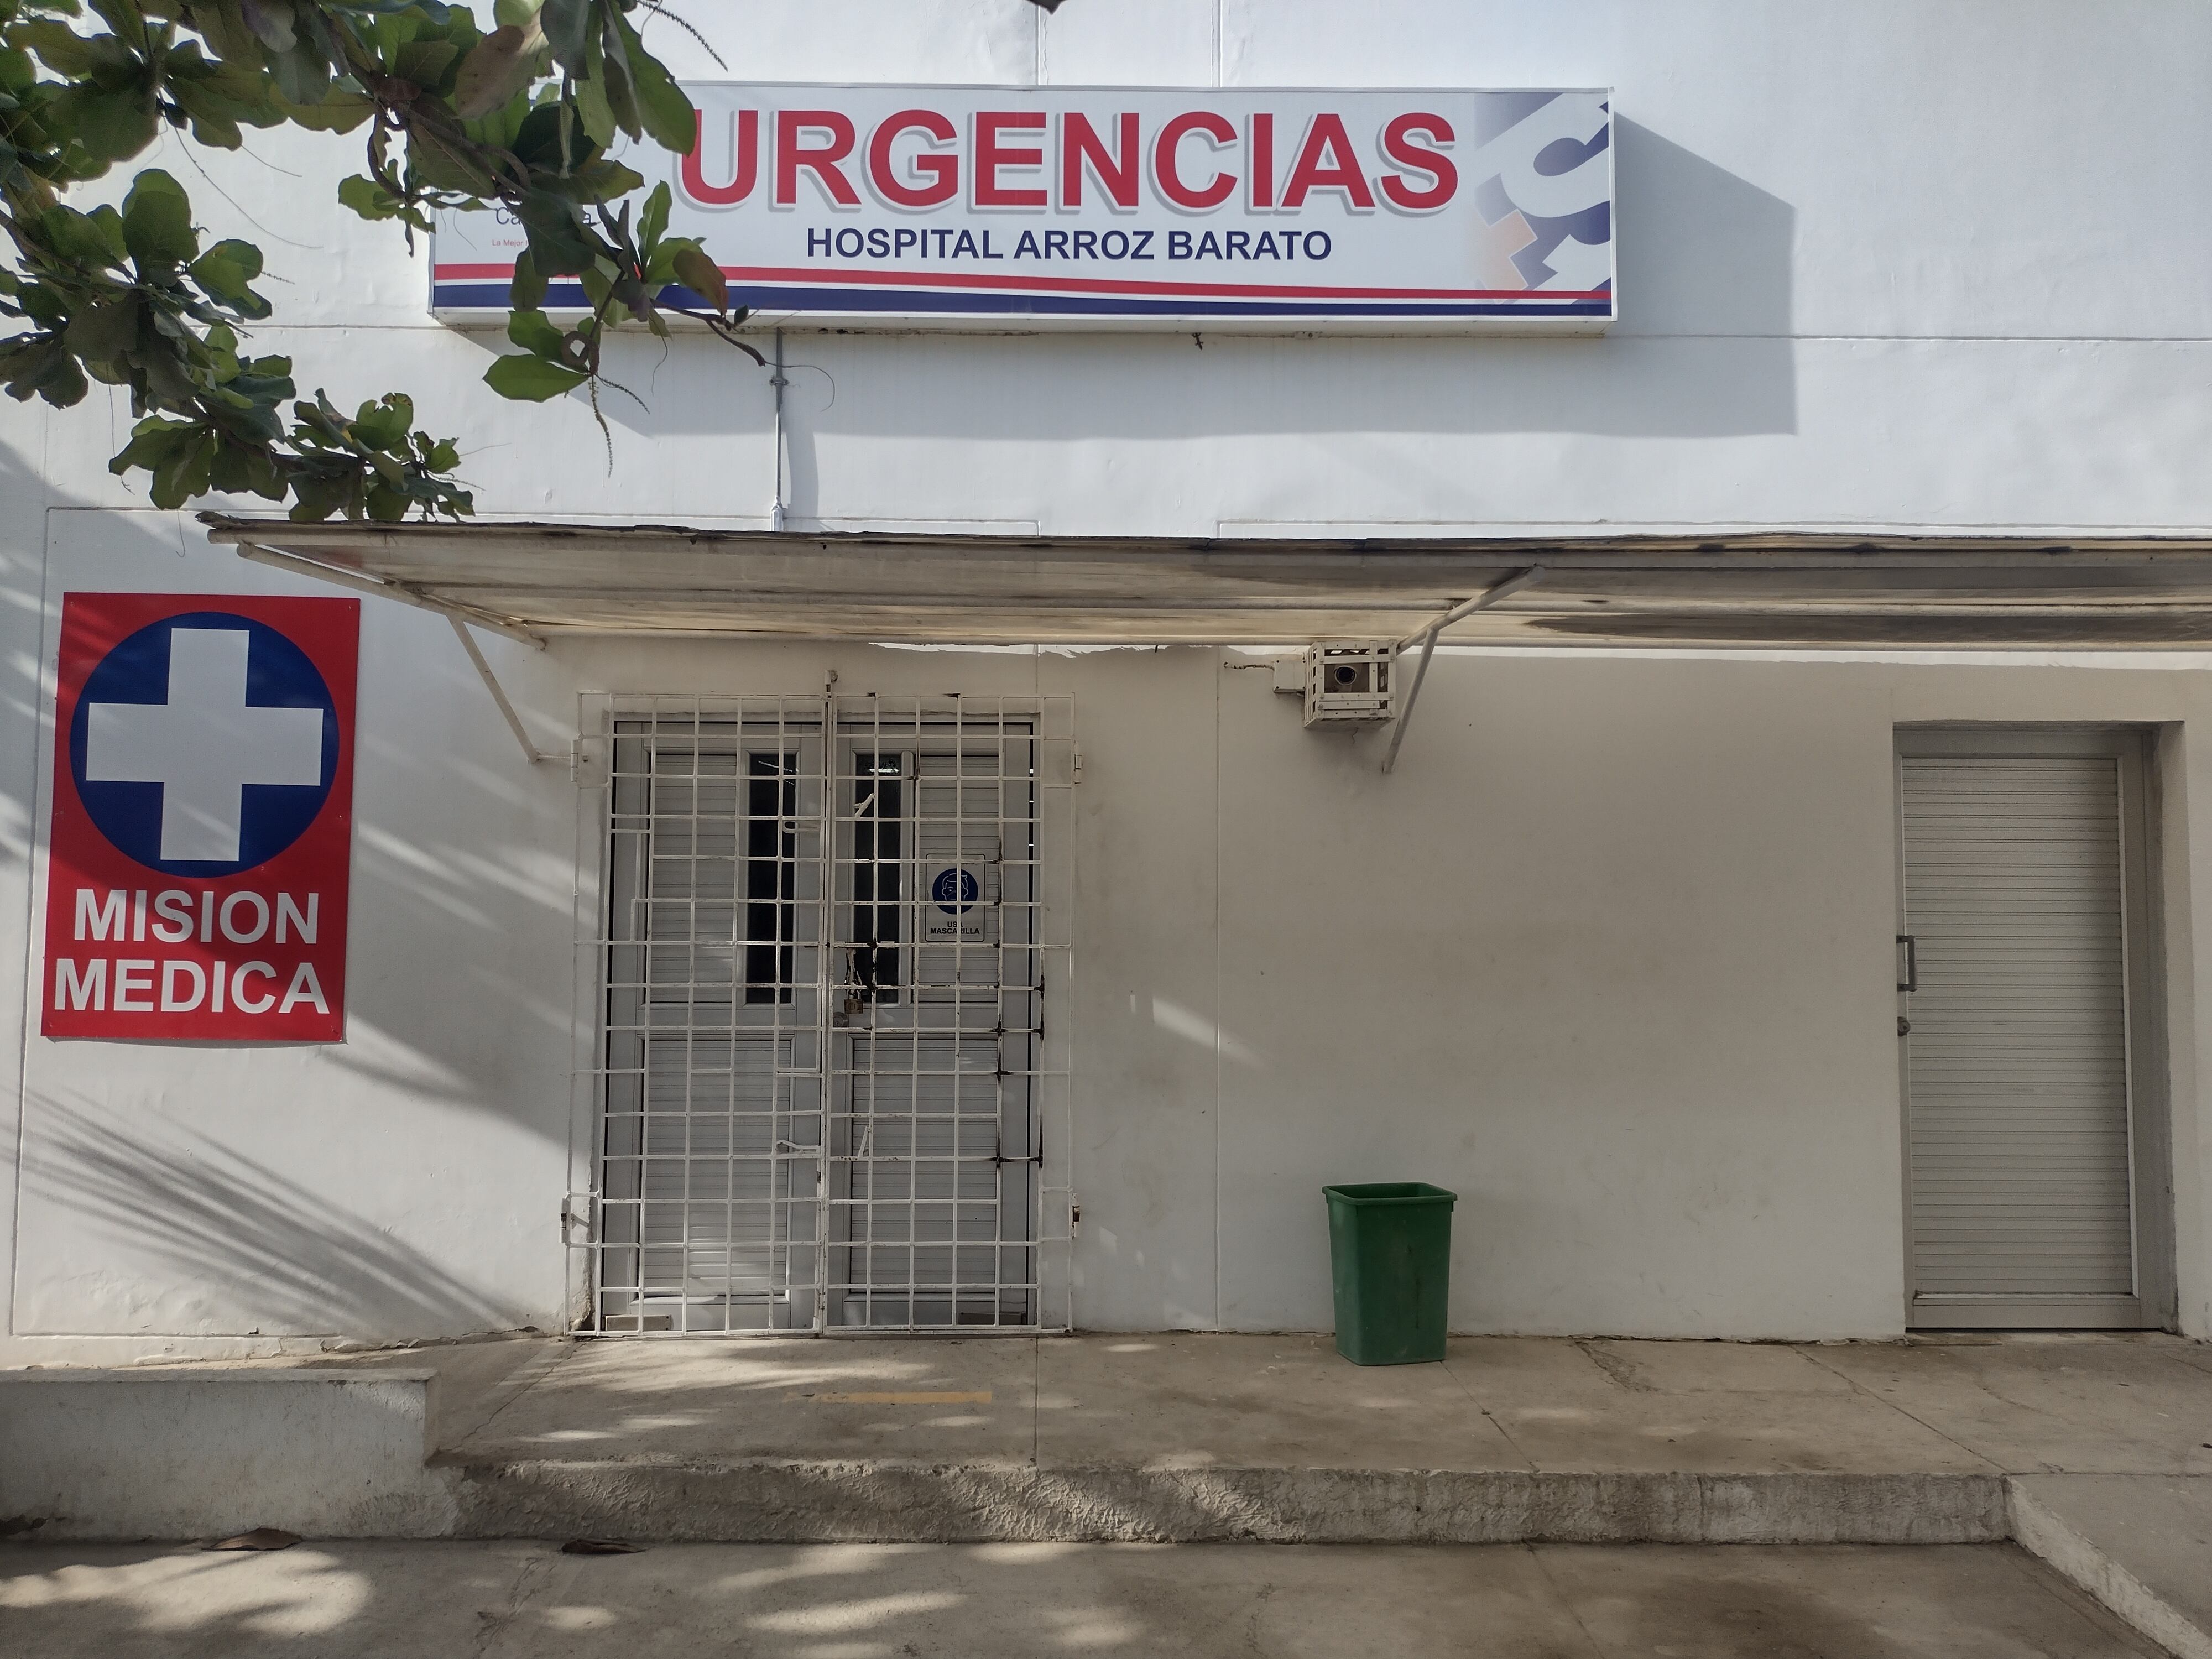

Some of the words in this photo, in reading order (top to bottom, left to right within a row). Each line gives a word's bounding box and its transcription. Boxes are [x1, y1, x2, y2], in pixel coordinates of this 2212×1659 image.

[679, 109, 1459, 211] URGENCIAS
[503, 239, 523, 248] Mejor
[808, 227, 1004, 260] HOSPITAL
[1014, 229, 1156, 260] ARROZ
[1168, 230, 1332, 262] BARATO
[74, 888, 319, 945] MISION
[54, 958, 330, 1014] MEDICA
